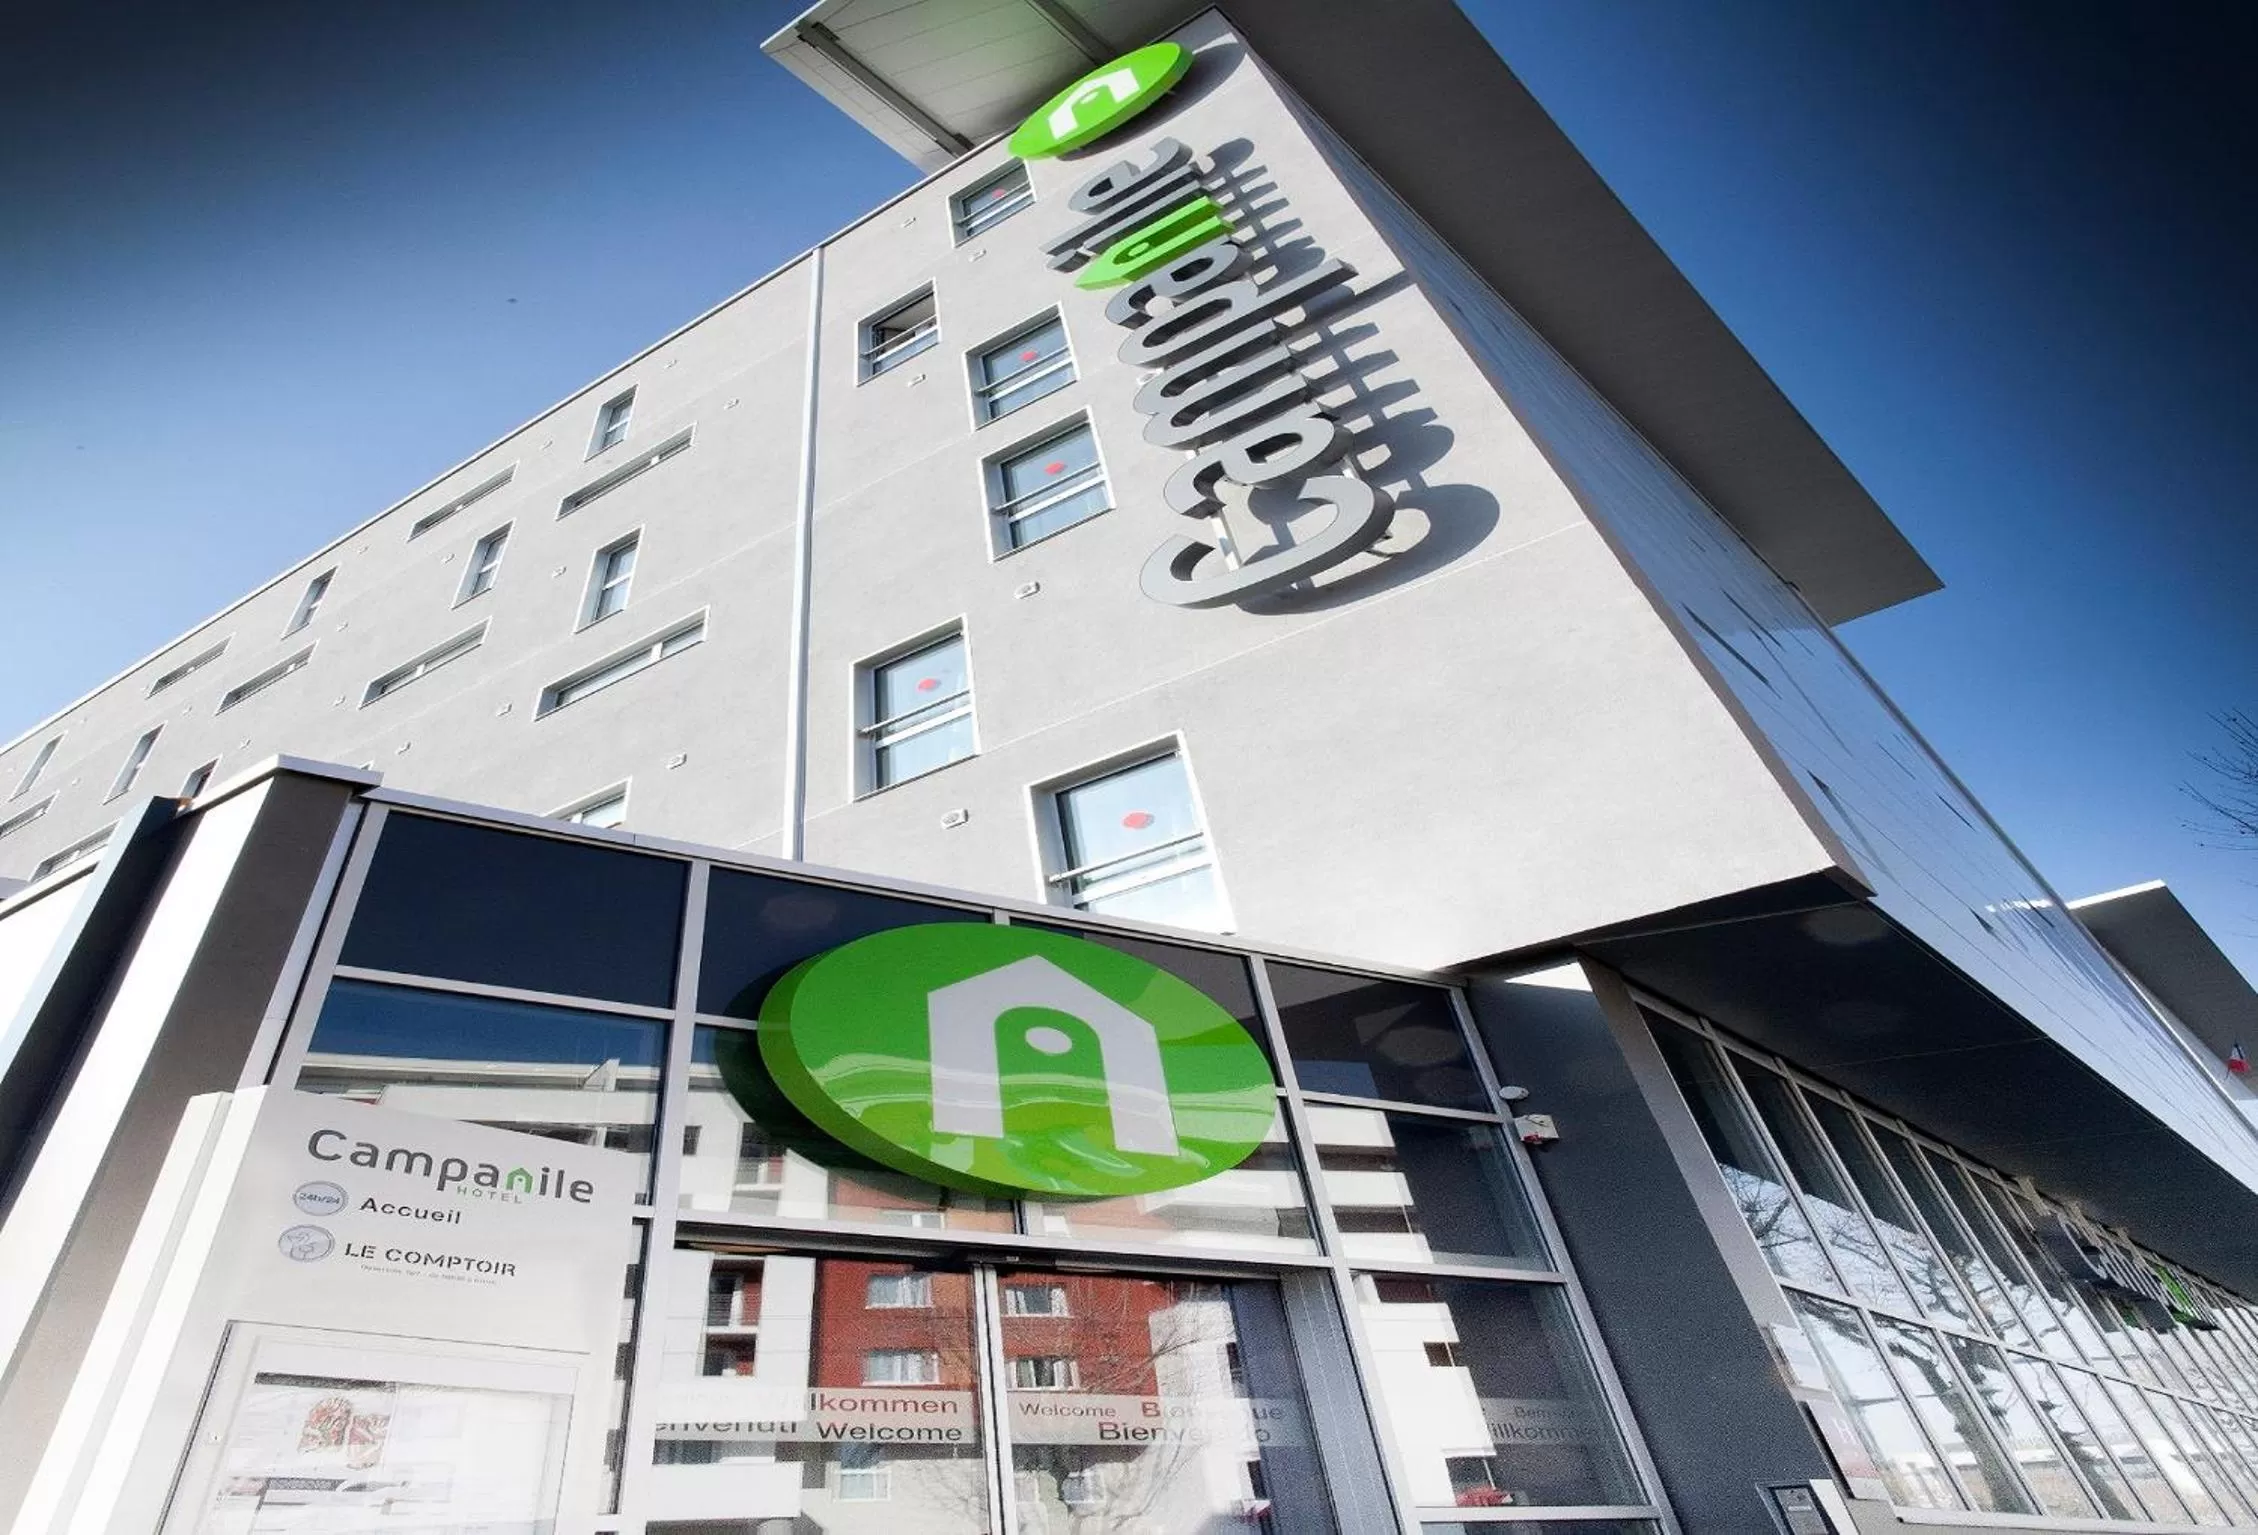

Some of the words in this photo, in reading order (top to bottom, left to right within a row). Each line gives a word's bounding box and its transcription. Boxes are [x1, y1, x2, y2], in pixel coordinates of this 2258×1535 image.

[1039, 136, 1388, 608] Campanile
[307, 1129, 595, 1204] Campanile
[360, 1197, 462, 1224] Accueil
[344, 1242, 377, 1260] LE
[384, 1248, 517, 1277] COMPTOIR
[1018, 1401, 1117, 1418] Welcome
[816, 1422, 963, 1441] Welcome
